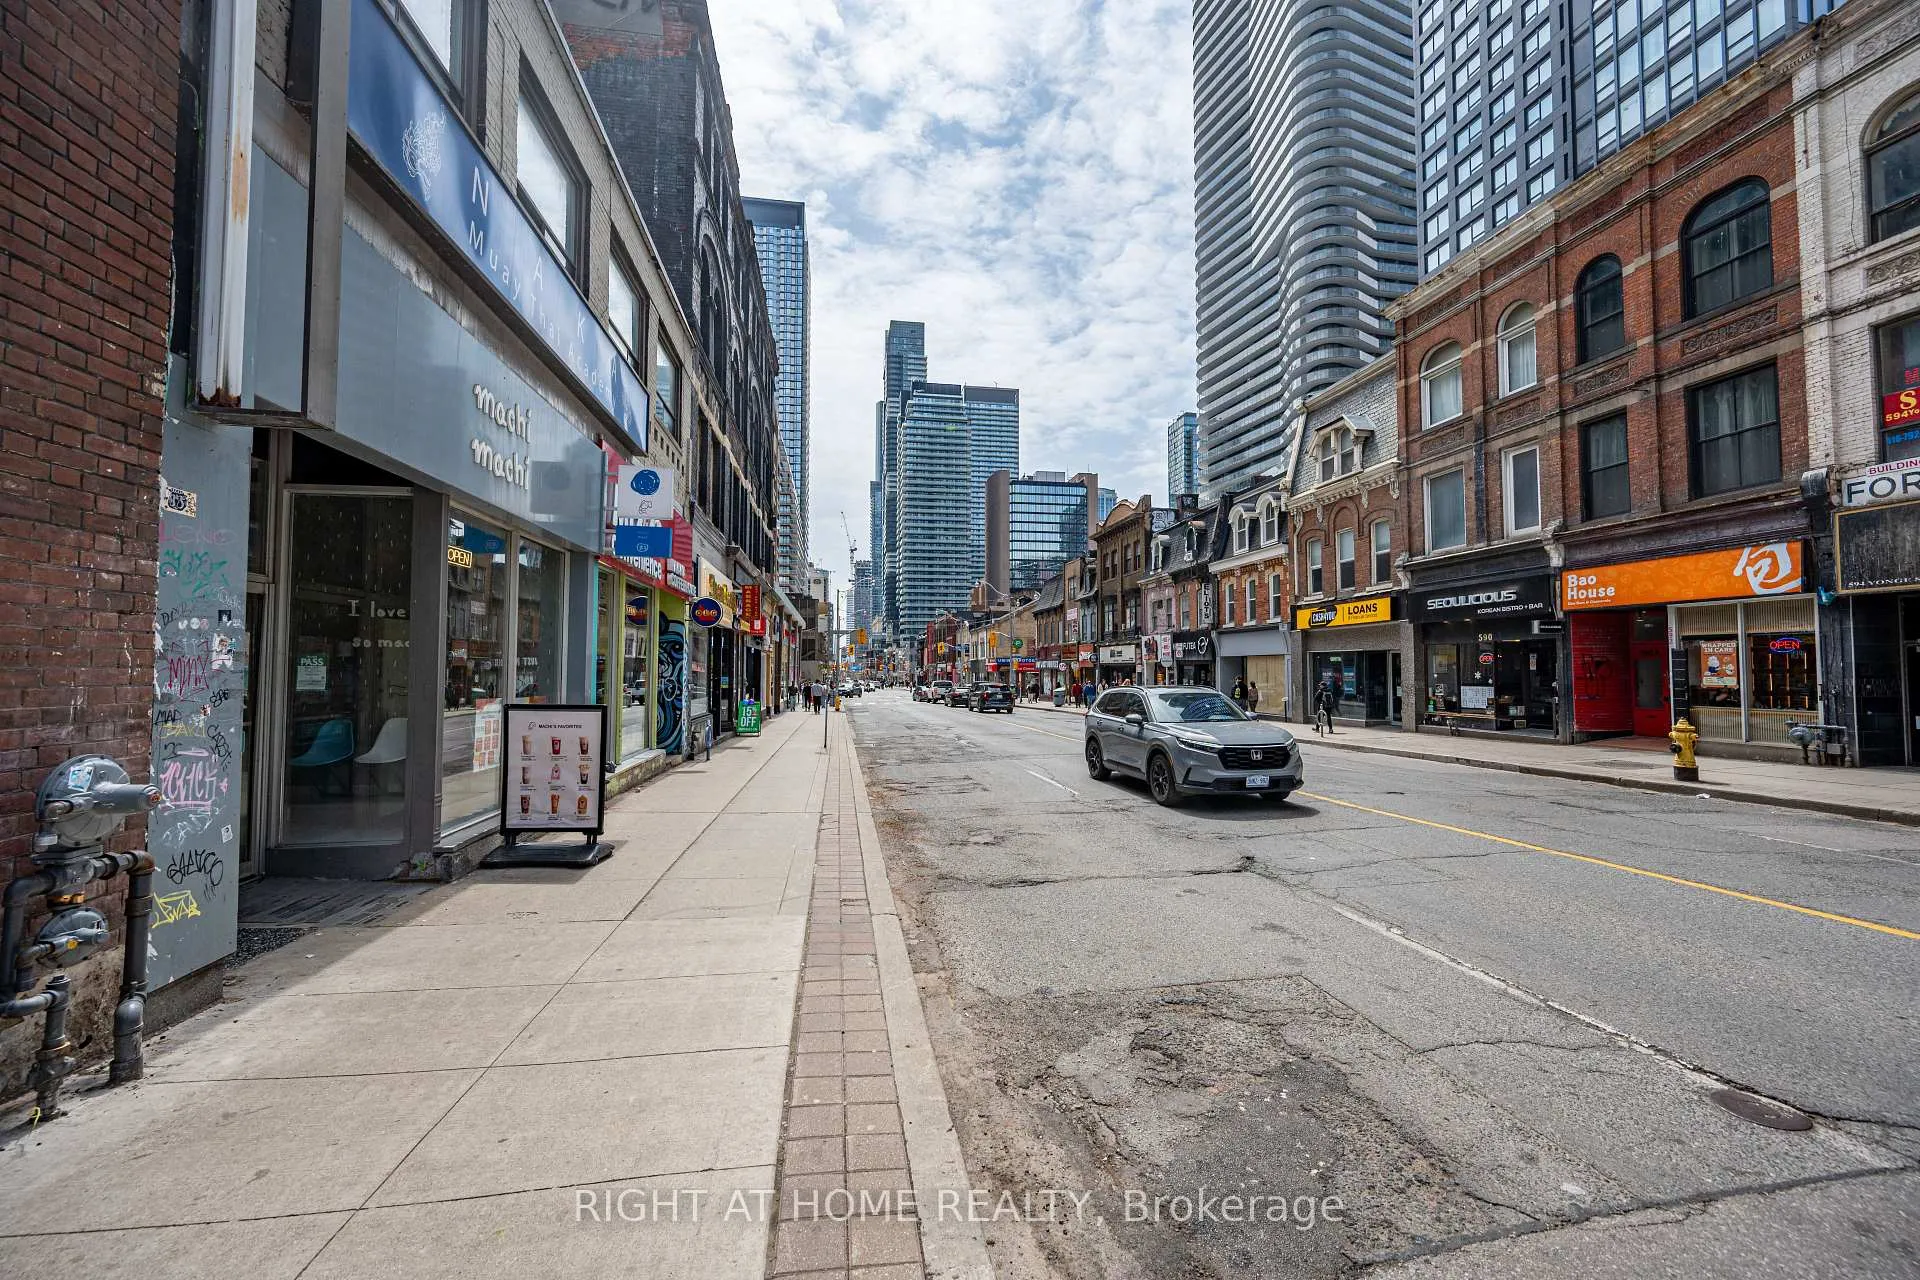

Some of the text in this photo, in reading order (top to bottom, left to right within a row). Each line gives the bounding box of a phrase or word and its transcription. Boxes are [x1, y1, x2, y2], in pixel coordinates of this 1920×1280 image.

[468, 220, 521, 301] Muay
[473, 383, 533, 444] machi
[470, 438, 530, 491] machi
[1868, 459, 1920, 475] BUILDIN
[447, 547, 470, 565] OPEN
[1567, 575, 1597, 588] Bao
[1426, 589, 1518, 610] SEOULICIOUS
[1567, 587, 1615, 600] House
[348, 599, 407, 618] I love
[1348, 603, 1378, 616] LOANS
[1477, 606, 1501, 615] KOREAN
[1502, 604, 1524, 612] BISTRO
[1529, 602, 1543, 610] BAR
[1478, 633, 1493, 642] 590
[1769, 640, 1800, 651] OPEN
[300, 658, 325, 666] PASS
[740, 716, 757, 728] OFF
